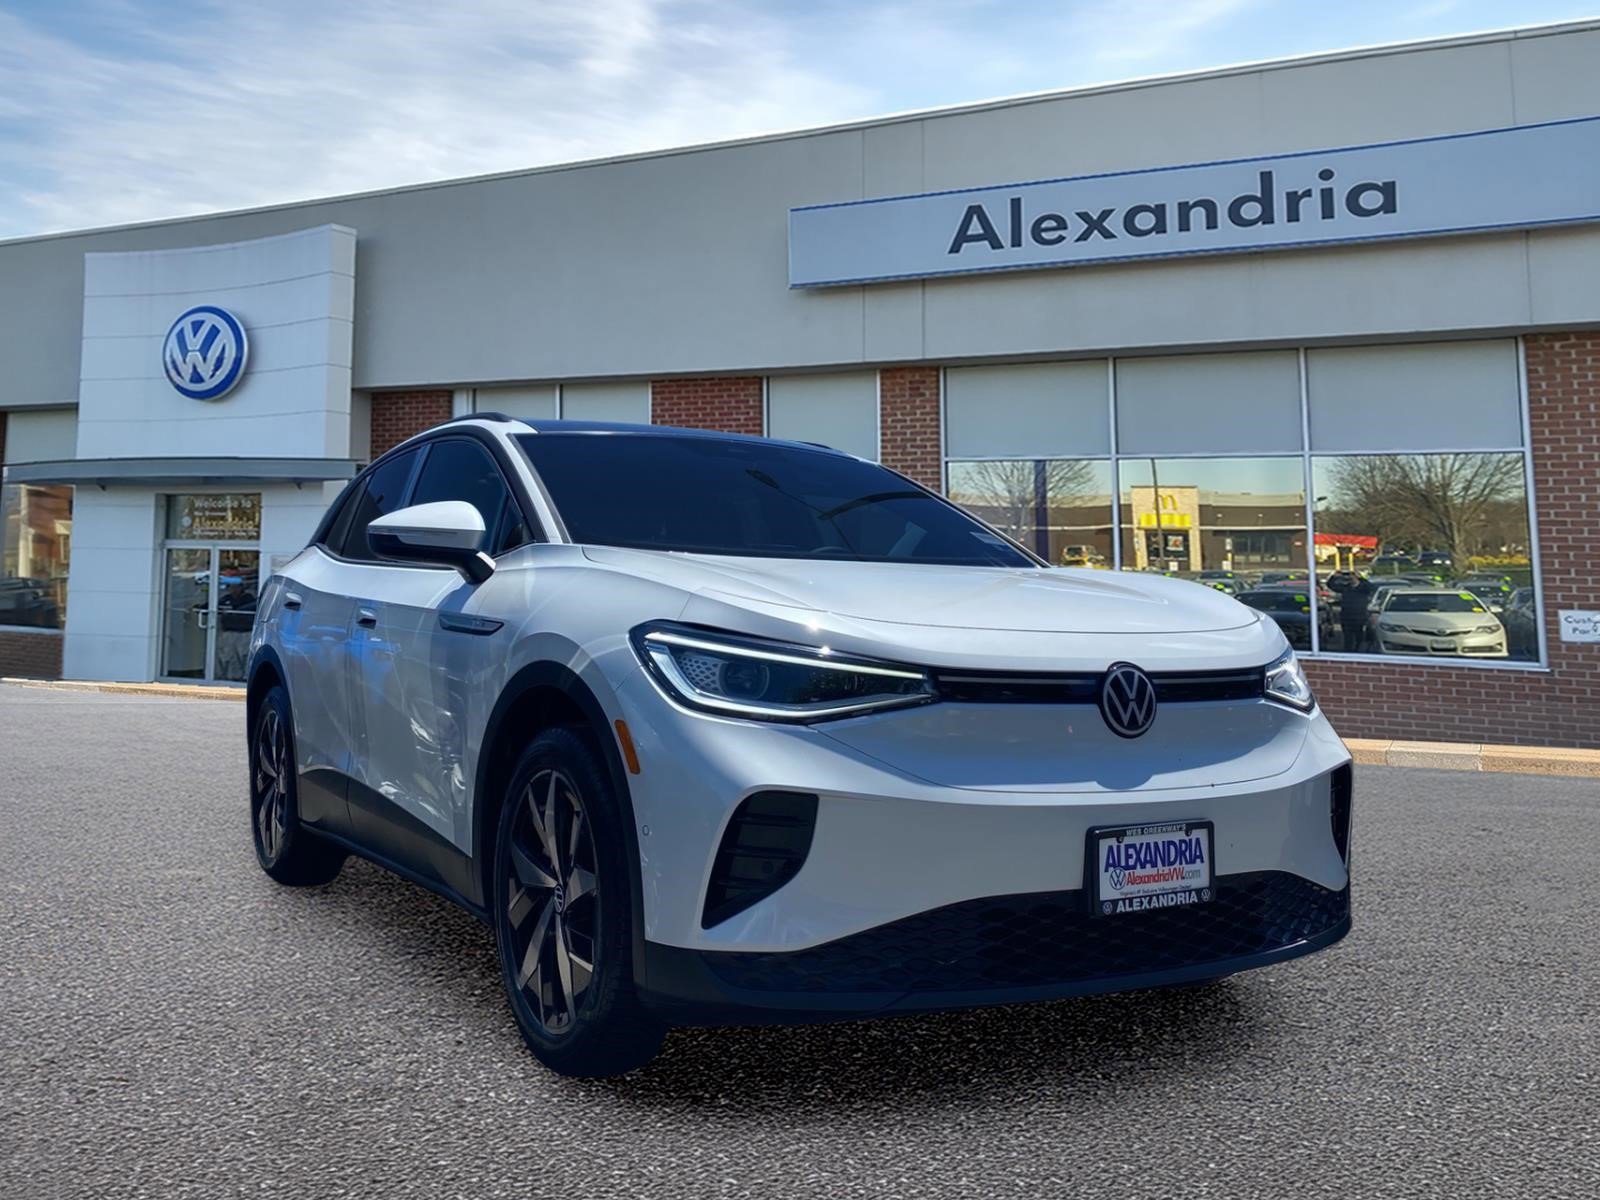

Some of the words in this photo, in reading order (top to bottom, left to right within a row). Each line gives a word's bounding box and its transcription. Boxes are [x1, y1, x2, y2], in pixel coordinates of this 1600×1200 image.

[947, 167, 1399, 255] Alexandria
[1102, 666, 1157, 736] VW
[1104, 837, 1204, 873] ALEXANDRIA
[1116, 891, 1199, 913] ALEXANDRIA
